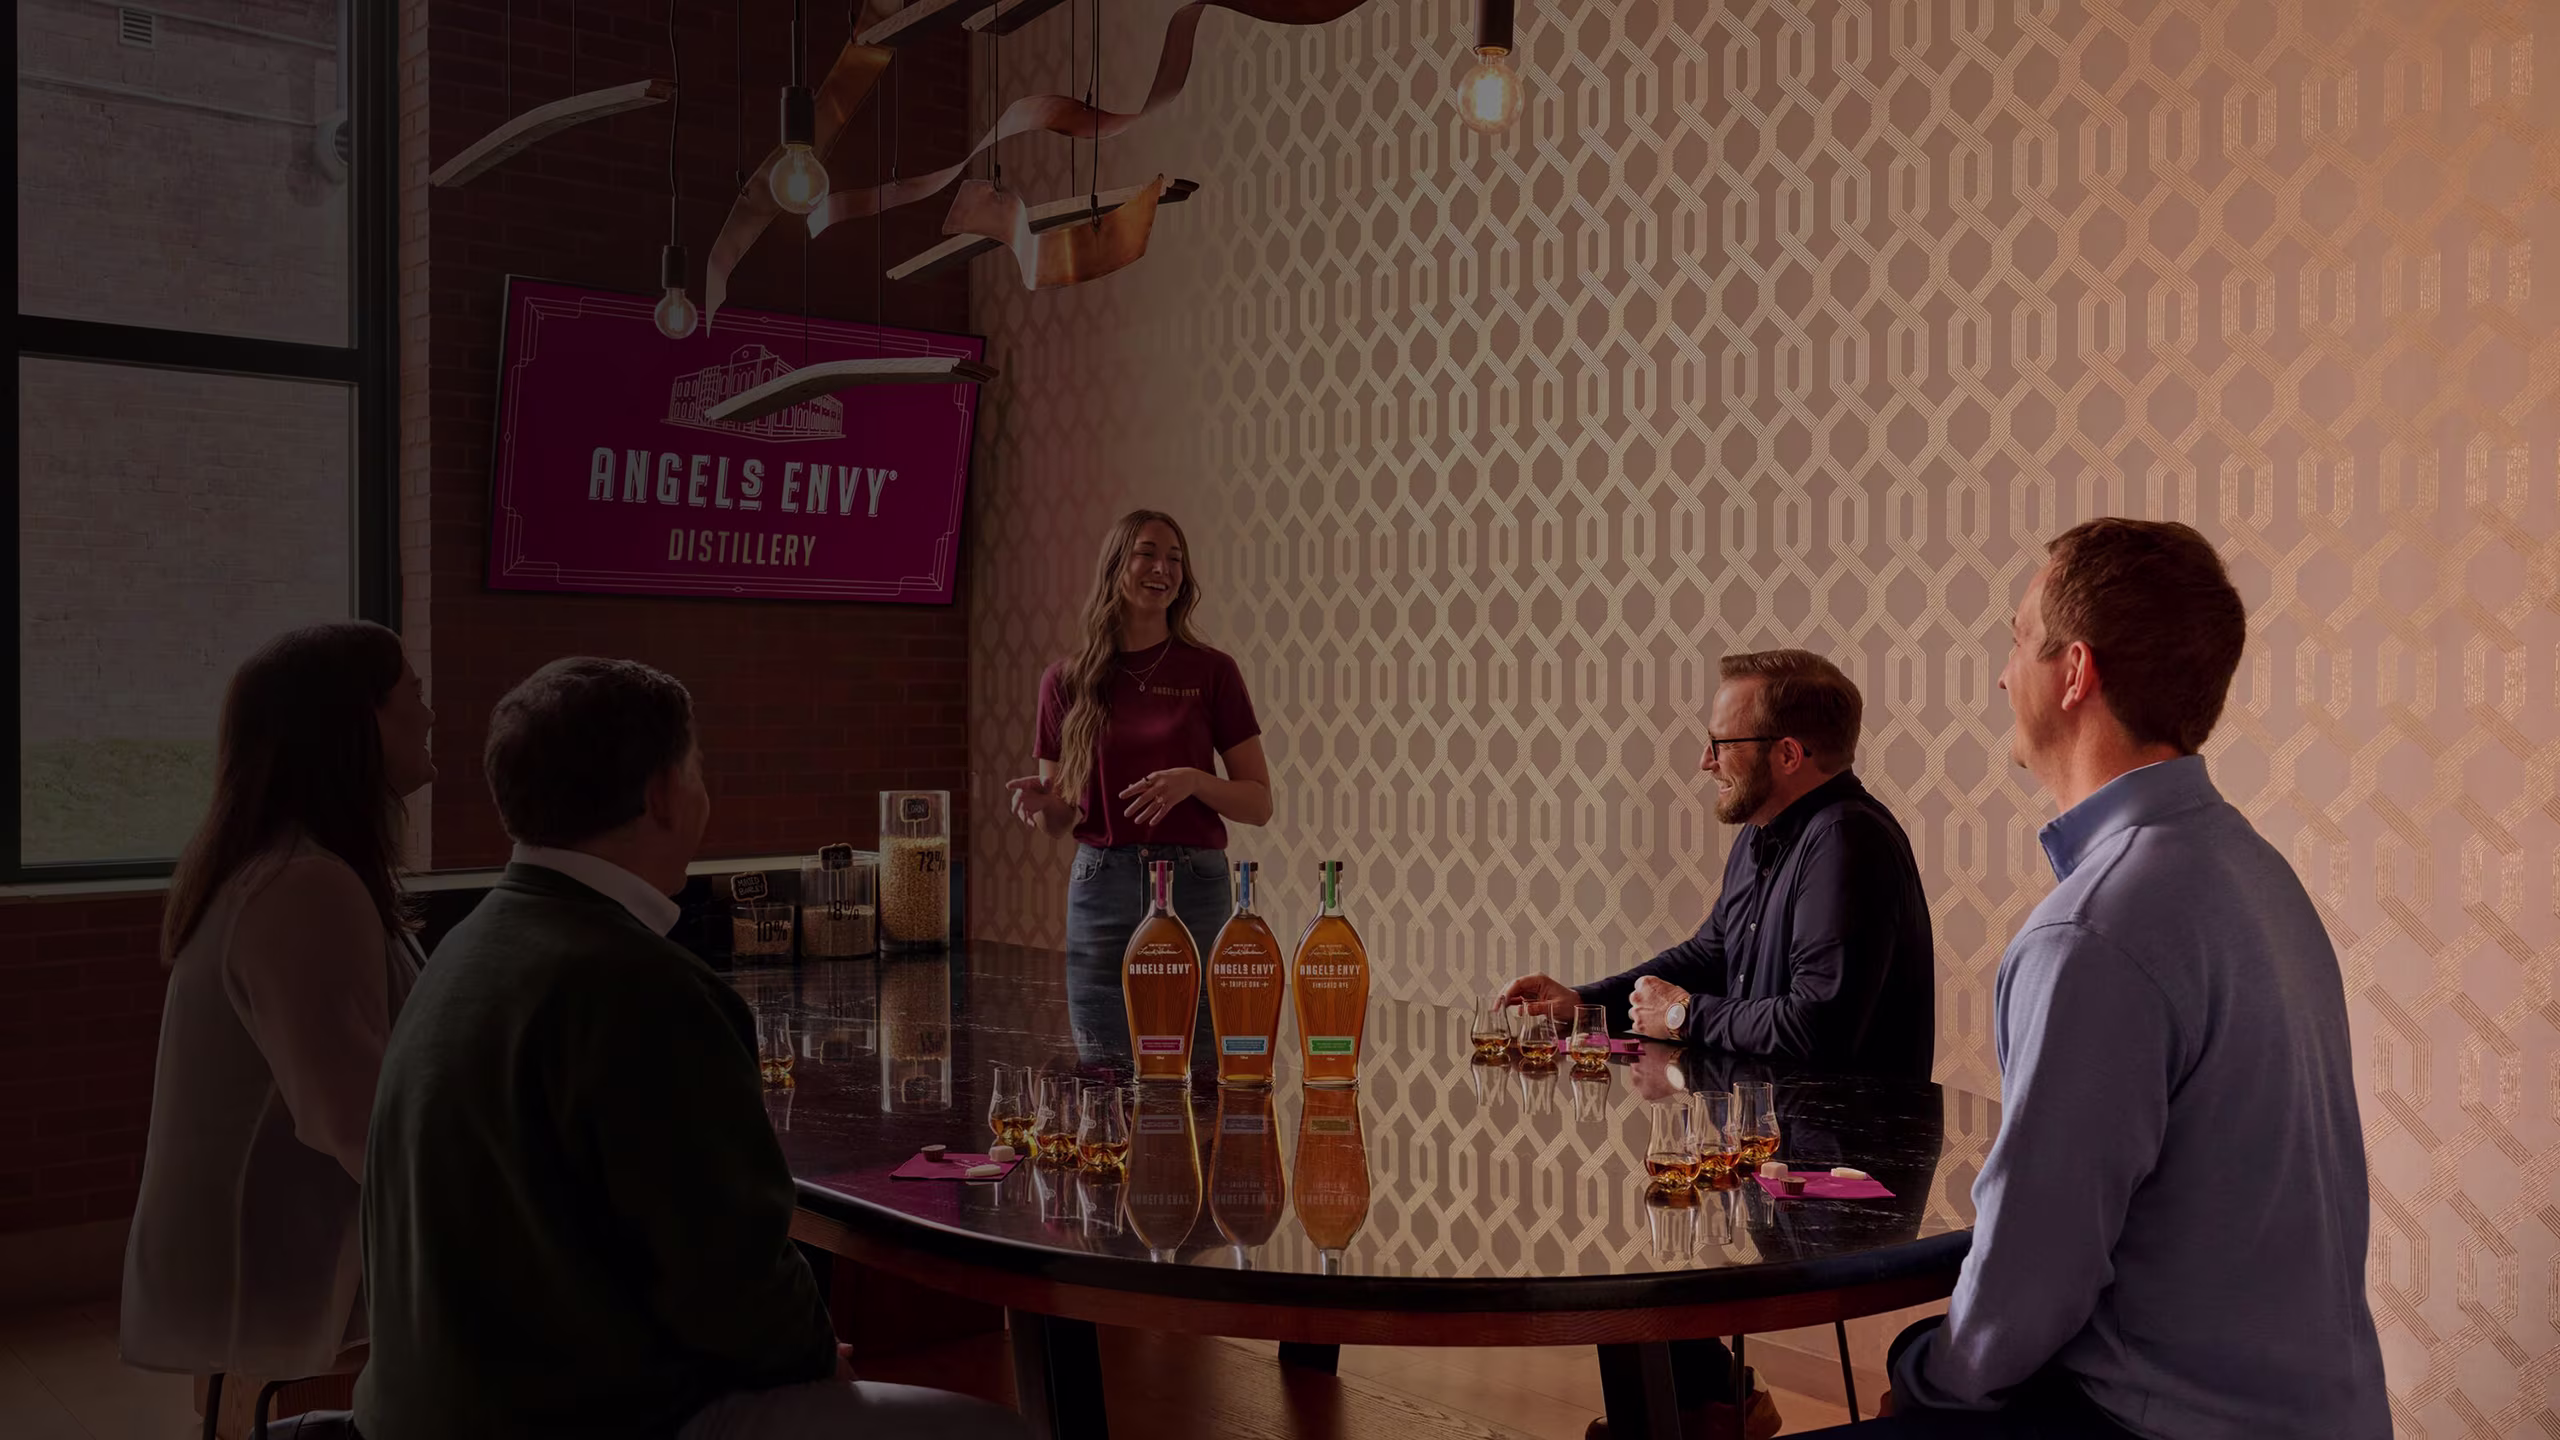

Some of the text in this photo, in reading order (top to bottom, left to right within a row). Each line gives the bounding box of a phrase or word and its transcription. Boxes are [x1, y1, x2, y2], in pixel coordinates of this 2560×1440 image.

[587, 446, 765, 511] ANGELS
[667, 527, 817, 567] DISTILLERY
[917, 850, 945, 872] 72%
[826, 900, 860, 921] 18%
[757, 920, 788, 943] 10%
[1129, 963, 1164, 975] ANGELS
[1213, 963, 1249, 975] ANGELS
[1299, 964, 1335, 976] ANGELS
